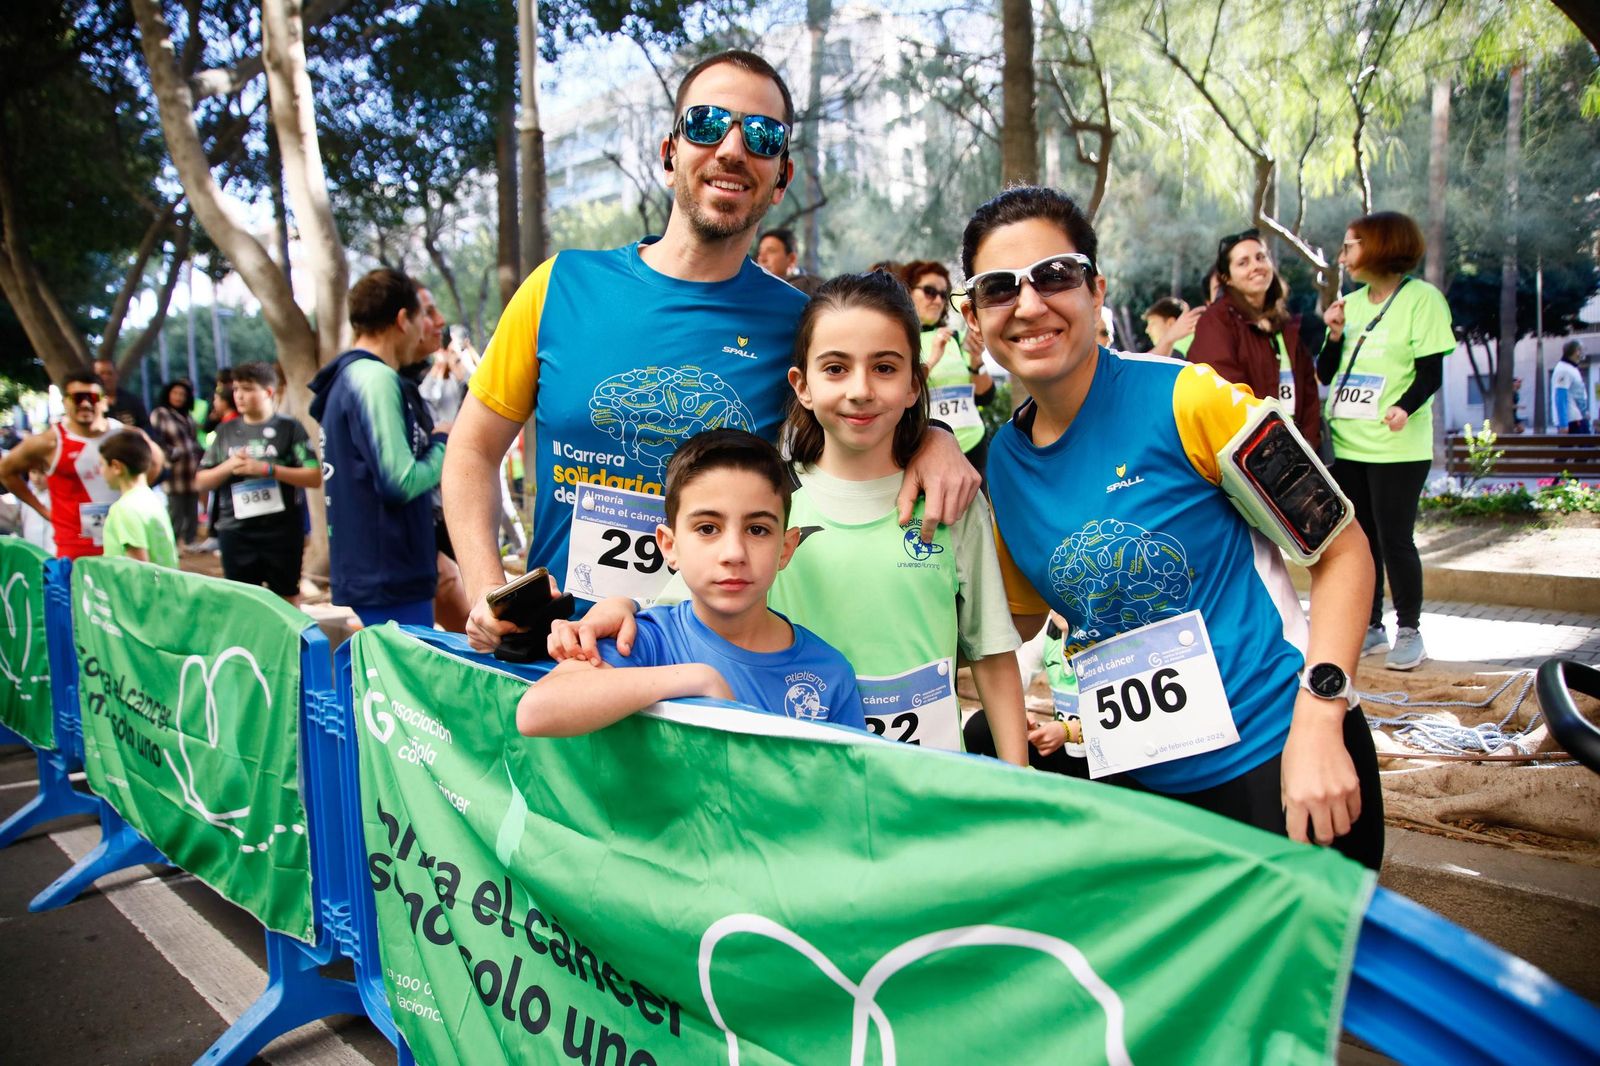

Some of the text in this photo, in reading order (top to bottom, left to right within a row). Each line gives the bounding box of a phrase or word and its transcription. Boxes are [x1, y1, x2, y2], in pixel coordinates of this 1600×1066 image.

[722, 346, 758, 360] SPALL
[553, 440, 625, 468] III Carrera
[553, 464, 662, 496] solidaria
[1106, 475, 1145, 493] SPALL
[617, 508, 628, 518] el
[630, 511, 668, 524] cáncer
[598, 529, 677, 575] 29
[1097, 664, 1105, 673] el
[1106, 654, 1136, 671] cáncer
[785, 671, 827, 692] Atletismo
[863, 695, 900, 704] cáncer
[1096, 668, 1187, 730] 506
[1159, 745, 1168, 753] de
[1168, 739, 1194, 752] febrero
[1194, 737, 1205, 745] de
[471, 875, 515, 938] el
[524, 907, 684, 1038] cáncer
[396, 974, 420, 991] 100
